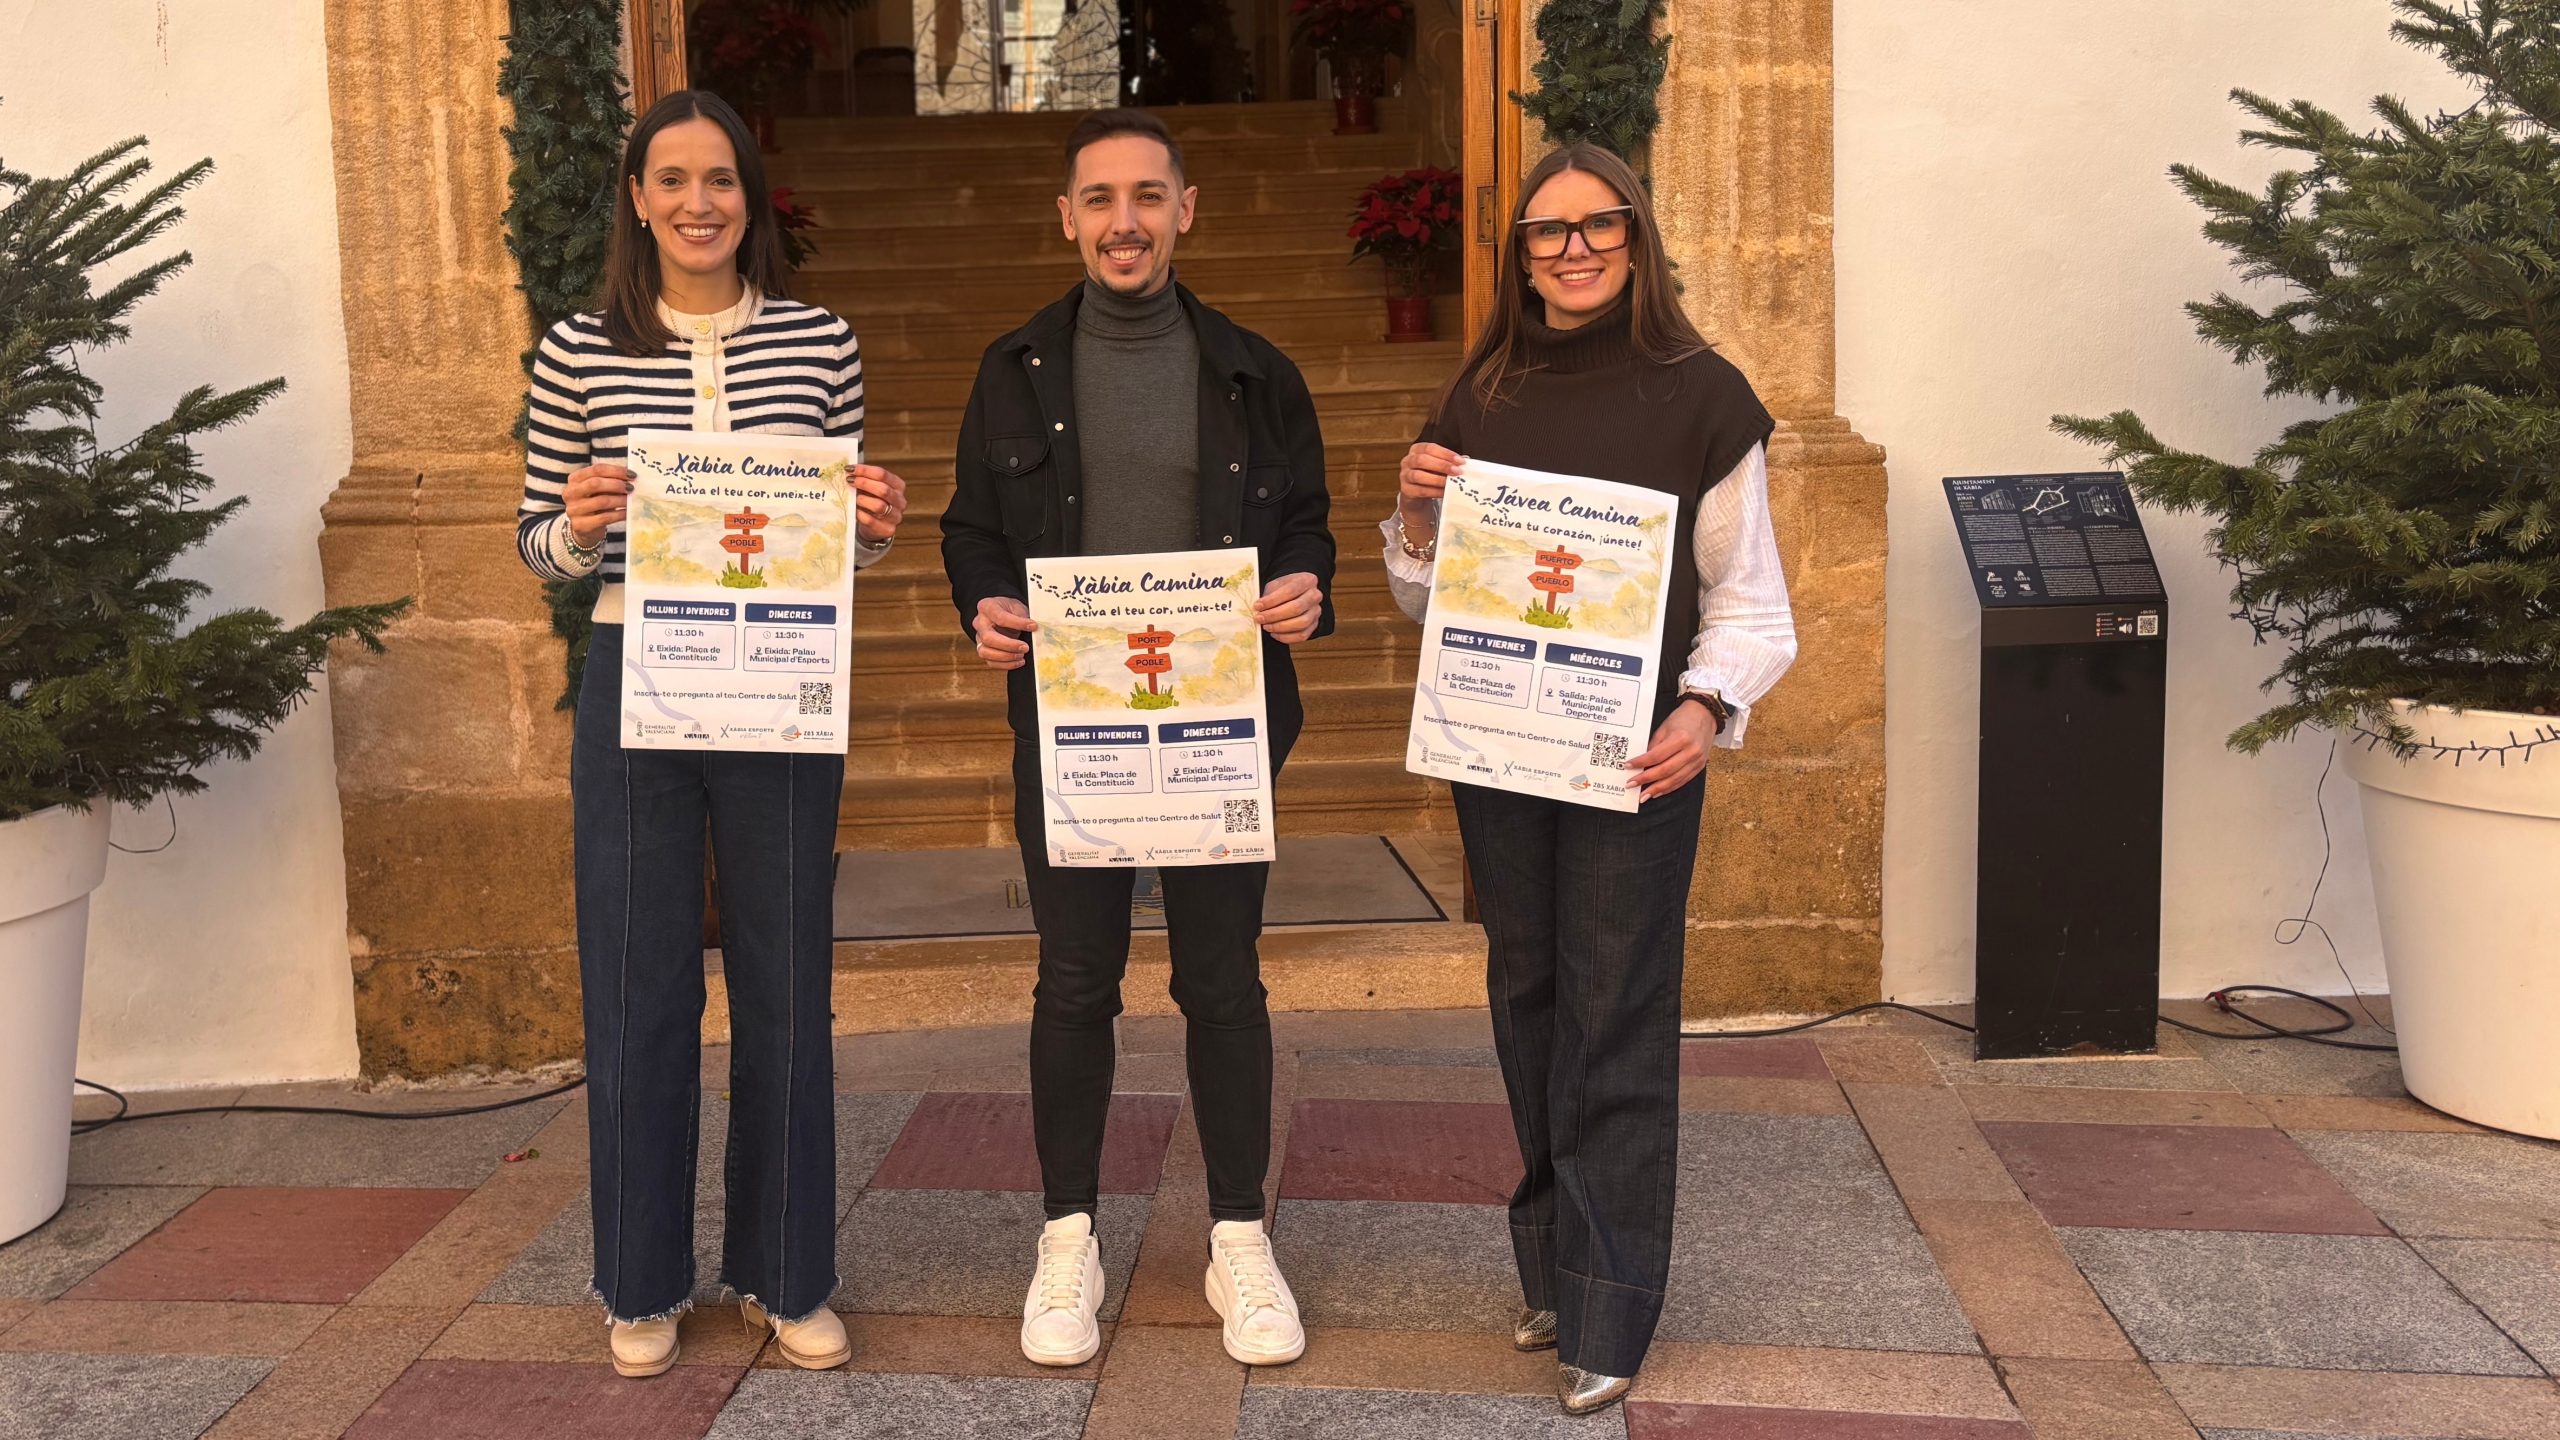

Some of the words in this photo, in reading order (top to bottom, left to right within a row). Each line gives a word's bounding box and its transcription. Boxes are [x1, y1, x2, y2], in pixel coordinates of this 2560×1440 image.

[674, 453, 735, 475] Xàbia
[742, 456, 825, 479] Camina
[666, 484, 706, 495] Activa
[711, 487, 720, 495] el
[725, 487, 743, 497] teu
[748, 490, 770, 499] cor,
[774, 490, 825, 501] uneix-te!
[1492, 485, 1552, 512] Jávea
[1558, 496, 1641, 528] Camina
[1480, 514, 1522, 531] Activa
[1527, 522, 1540, 532] tu
[1544, 527, 1596, 542] corazón,
[1599, 535, 1642, 550] ¡únete!
[1540, 554, 1574, 566] PUERTO
[1072, 574, 1134, 596] Xàbia
[1141, 572, 1227, 592] Camina
[1536, 576, 1569, 587] PUEBLO
[647, 606, 678, 614] DILLUNS
[686, 607, 729, 616] DIVENDRES
[768, 610, 812, 620] DIMECRES
[1065, 607, 1106, 618] Activa
[1111, 607, 1120, 616] el
[1125, 606, 1145, 615] teu
[1150, 606, 1173, 615] cor,
[1178, 601, 1232, 613] uneix-te!
[1445, 632, 1474, 645] LUNES
[1477, 637, 1483, 645] Y
[1486, 639, 1526, 652] VIERNES
[657, 645, 684, 653] Eixida:
[685, 646, 708, 655] Plaça
[750, 655, 789, 664] Municipal
[790, 656, 830, 665] d'Esports
[1136, 658, 1164, 666] POBLE
[1570, 652, 1622, 669] MIÉRCOLES
[1470, 660, 1493, 671] 11:30
[1495, 664, 1500, 672] h
[1450, 681, 1458, 689] la
[1451, 674, 1479, 684] Salida:
[1480, 678, 1504, 688] Plaza
[1505, 682, 1516, 691] de
[1577, 676, 1599, 686] 11:30
[1601, 679, 1607, 687] h
[1559, 690, 1588, 701] Salida:
[1589, 695, 1622, 707] Palacio
[1562, 699, 1603, 713] Municipal
[1605, 706, 1616, 714] de
[1566, 708, 1607, 722] Deportes
[1058, 732, 1090, 740] DILLUNS
[1093, 732, 1095, 740] I
[1098, 731, 1142, 739] DIVENDRES
[1183, 727, 1230, 737] DIMECRES
[1469, 723, 1505, 735] pregunta
[1517, 731, 1526, 739] tu
[1527, 733, 1555, 744] Centro
[1557, 738, 1566, 746] de
[1568, 740, 1590, 750] Salud
[1212, 765, 1237, 773] Palau
[1533, 768, 1562, 778] ESPORTS
[1100, 771, 1124, 779] Plaça
[1167, 775, 1209, 783] Municipal
[1211, 772, 1253, 782] d'Esports
[1098, 818, 1135, 826] pregunta
